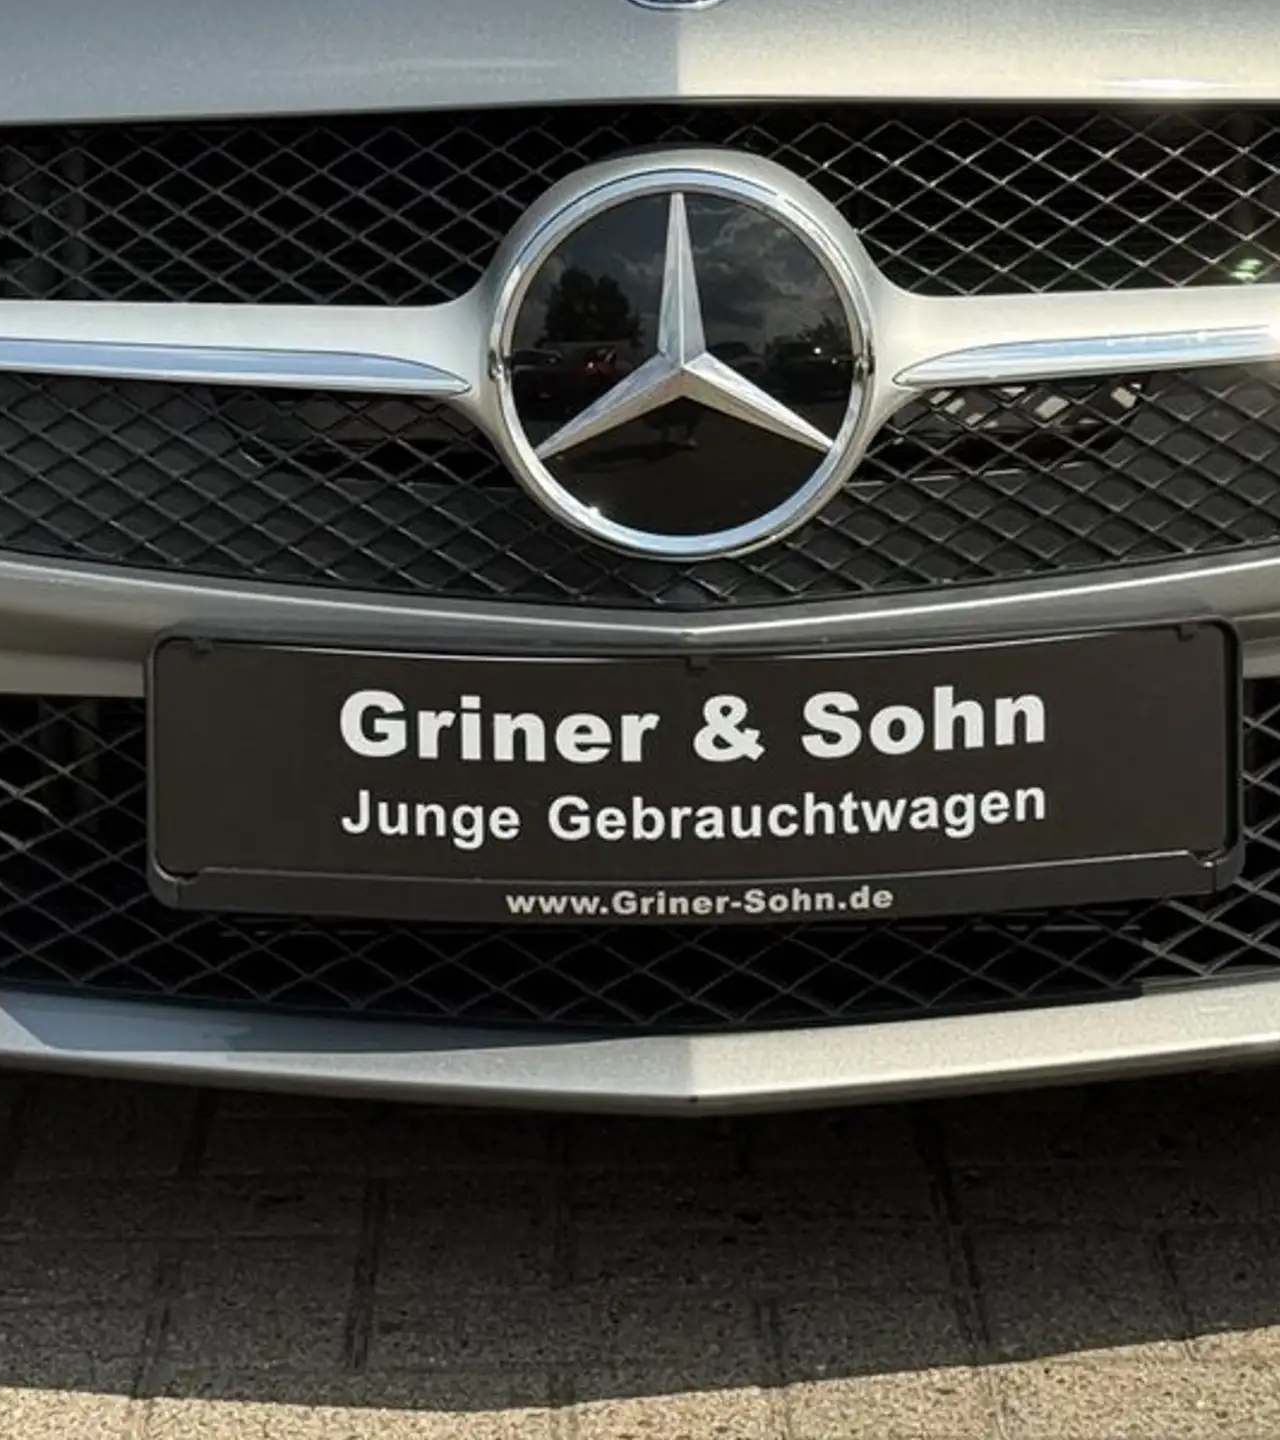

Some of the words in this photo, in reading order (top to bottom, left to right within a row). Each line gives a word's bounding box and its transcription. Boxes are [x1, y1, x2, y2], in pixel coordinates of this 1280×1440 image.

[339, 689, 661, 764] Griner
[692, 694, 766, 763] &
[800, 684, 1046, 759] Sohn
[340, 788, 521, 851] Junge
[547, 786, 1046, 841] Gebrauchtwagen
[505, 884, 894, 916] www.Griner-Sohn.de
